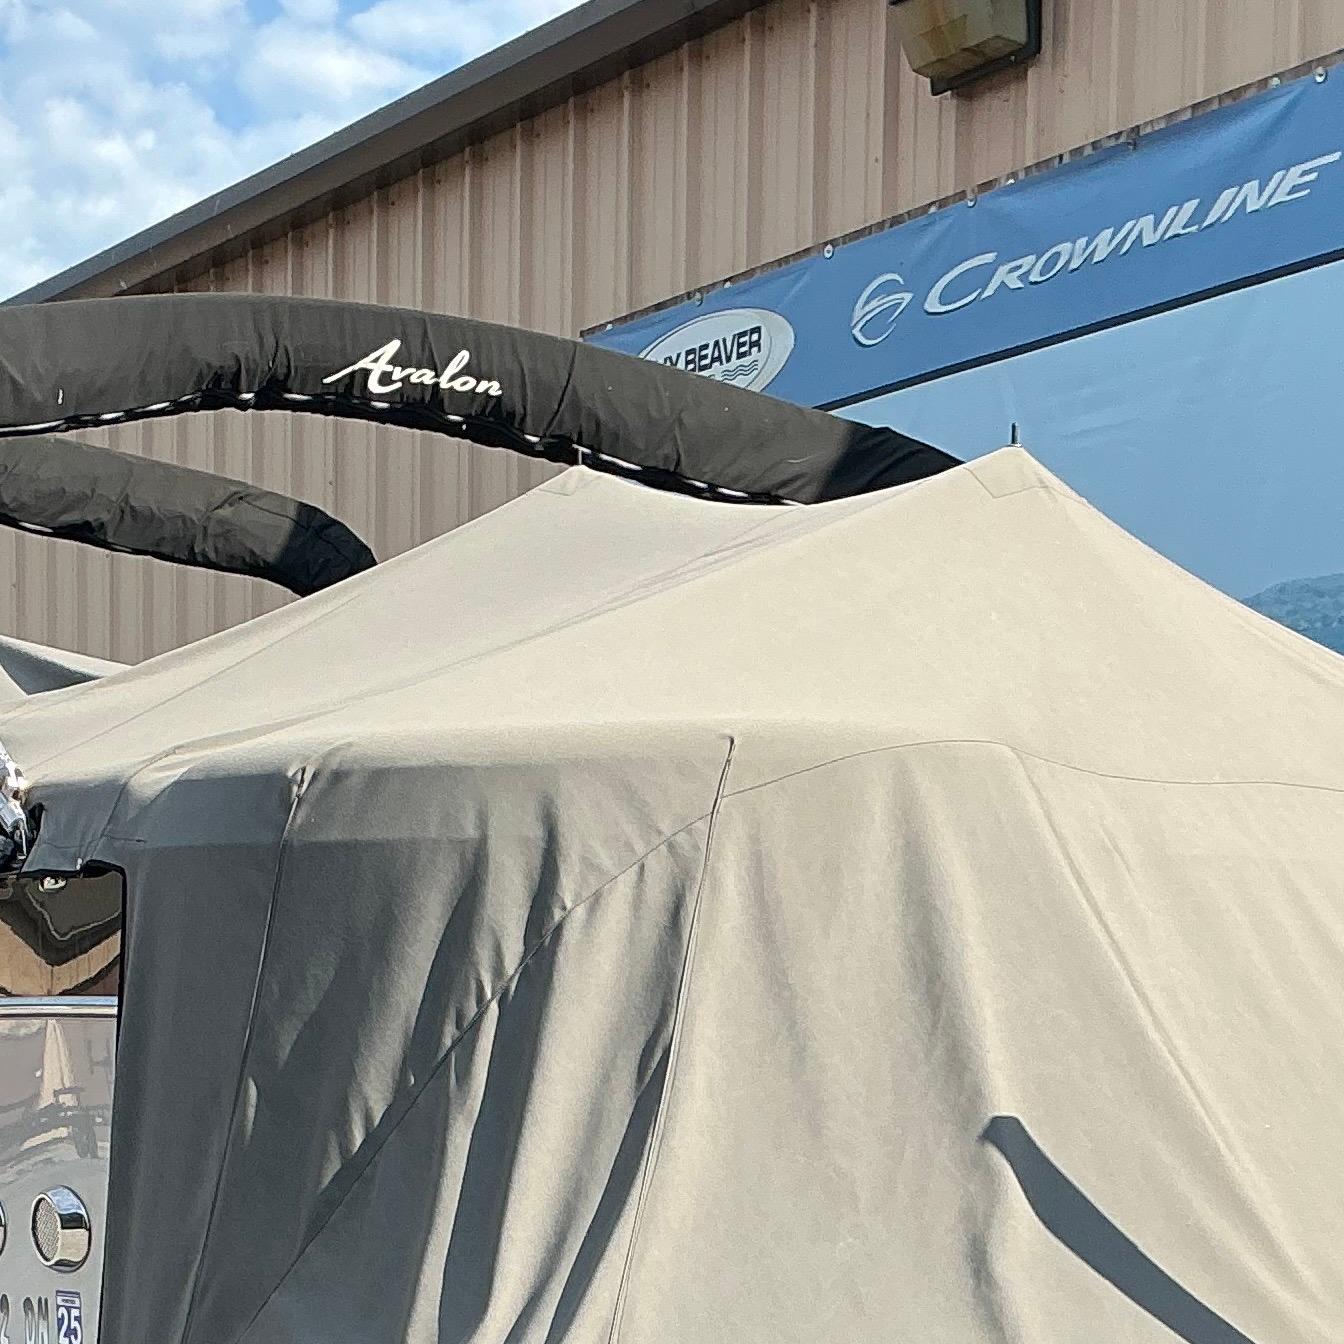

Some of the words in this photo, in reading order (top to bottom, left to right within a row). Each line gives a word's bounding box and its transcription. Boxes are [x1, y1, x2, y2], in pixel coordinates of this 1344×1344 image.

[923, 151, 1342, 315] CROWNLINE
[322, 339, 503, 397] Avalon
[685, 326, 762, 372] BEAVER
